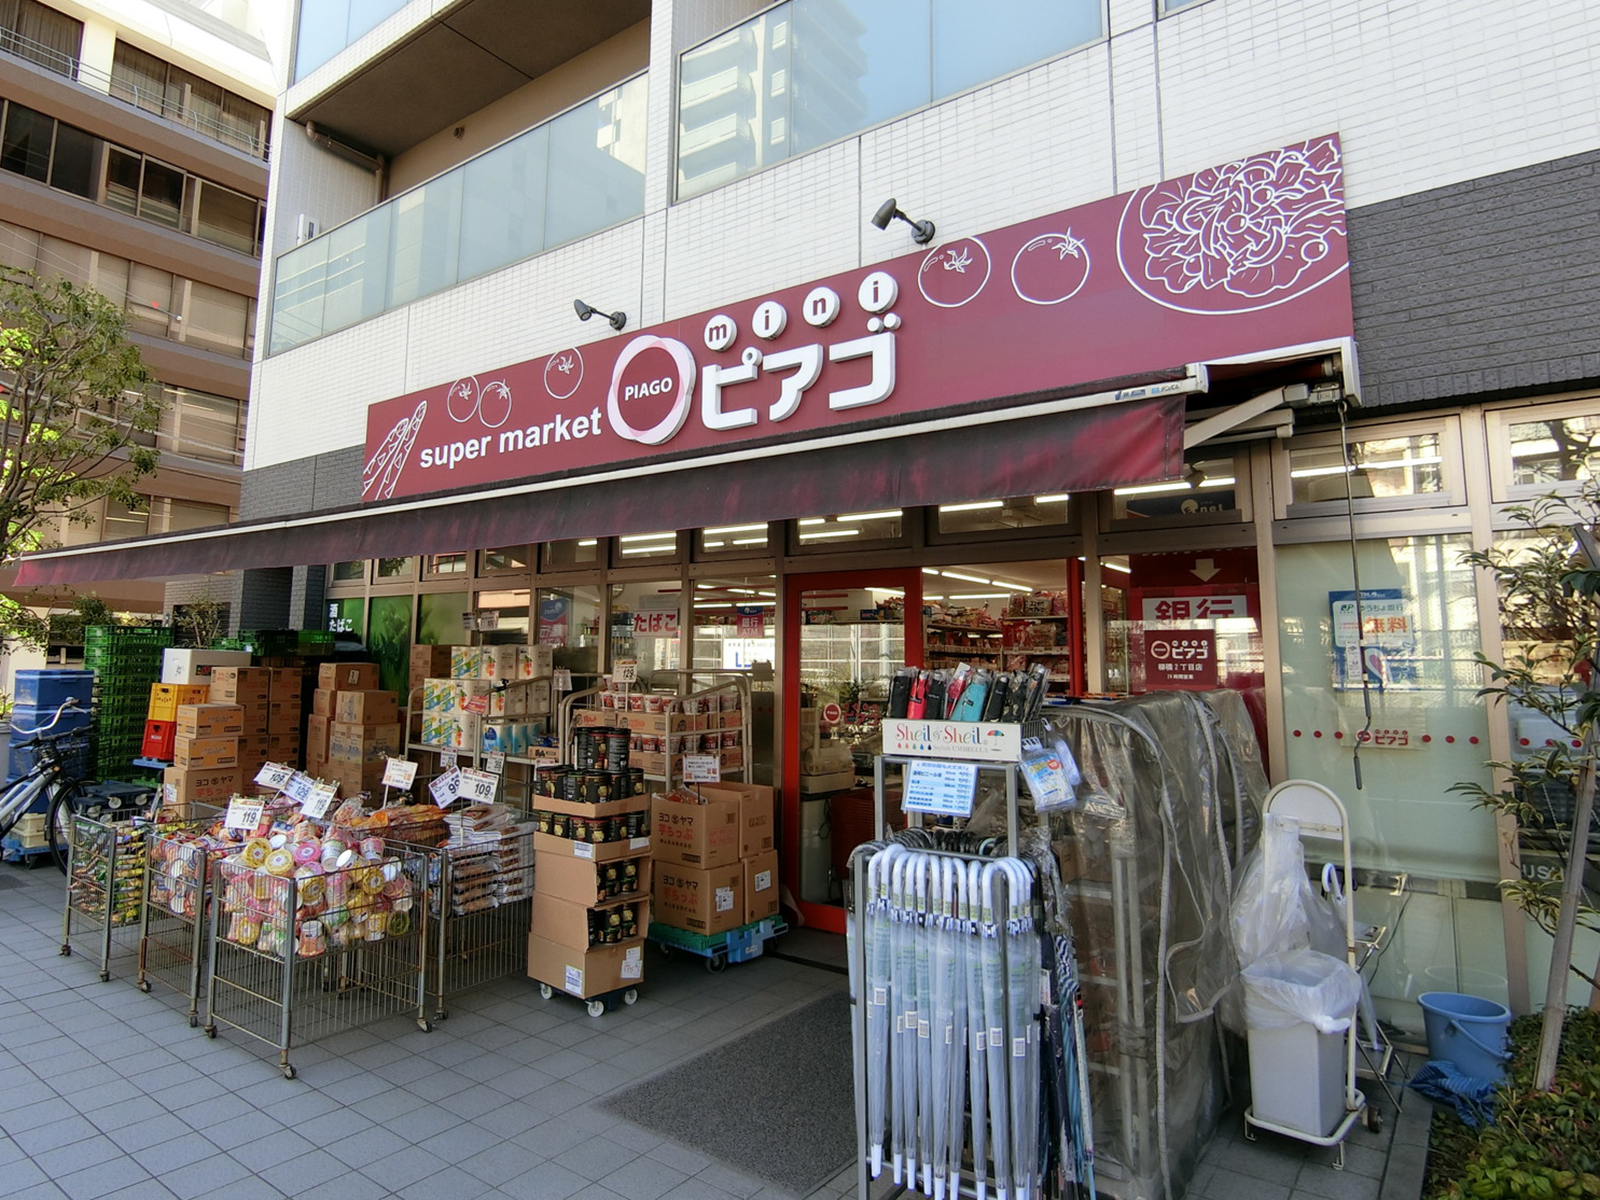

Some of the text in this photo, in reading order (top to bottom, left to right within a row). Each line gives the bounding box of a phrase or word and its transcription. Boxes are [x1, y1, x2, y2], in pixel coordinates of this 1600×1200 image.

[701, 313, 901, 430] ピアゴ
[624, 377, 673, 402] PIAGO
[419, 406, 602, 469] super market
[329, 603, 339, 618] 酒
[328, 618, 353, 632] たばこ
[633, 613, 678, 633] たばこ
[742, 628, 758, 636] ATM
[1172, 646, 1208, 659] ピアゴ
[895, 723, 932, 742] Sheil
[943, 725, 982, 744] Sheil
[1375, 734, 1408, 746] ピアゴ
[269, 773, 286, 784] 109
[295, 785, 310, 798] 129
[475, 782, 492, 796] 109
[242, 811, 257, 824] 119
[659, 812, 694, 826] ヨコ ヤマ
[663, 875, 698, 891] ヨコ ヤマ
